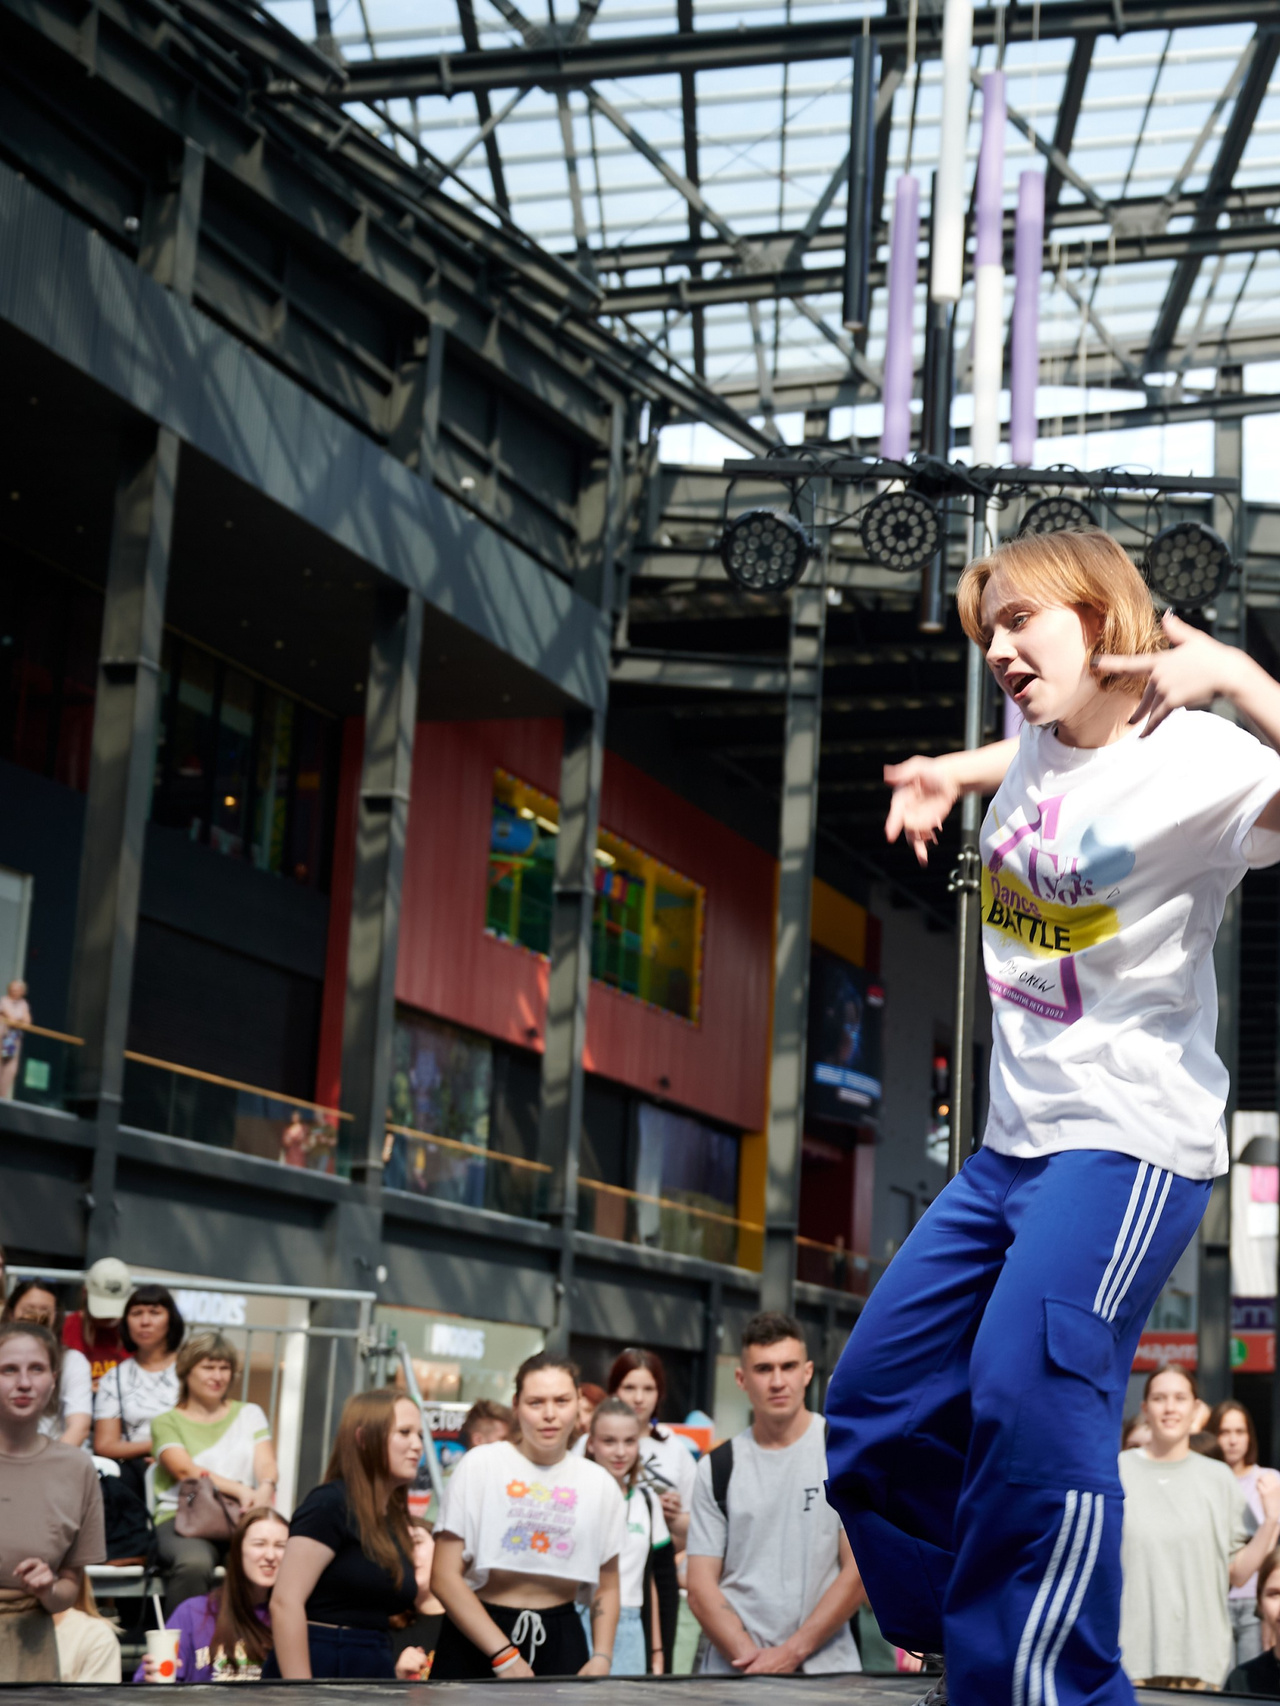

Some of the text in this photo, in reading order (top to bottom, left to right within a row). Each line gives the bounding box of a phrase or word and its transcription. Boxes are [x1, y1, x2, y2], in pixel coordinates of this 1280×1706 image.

[991, 876, 1042, 918] Dance
[986, 898, 1072, 953] BATTLE
[803, 1487, 819, 1512] F
